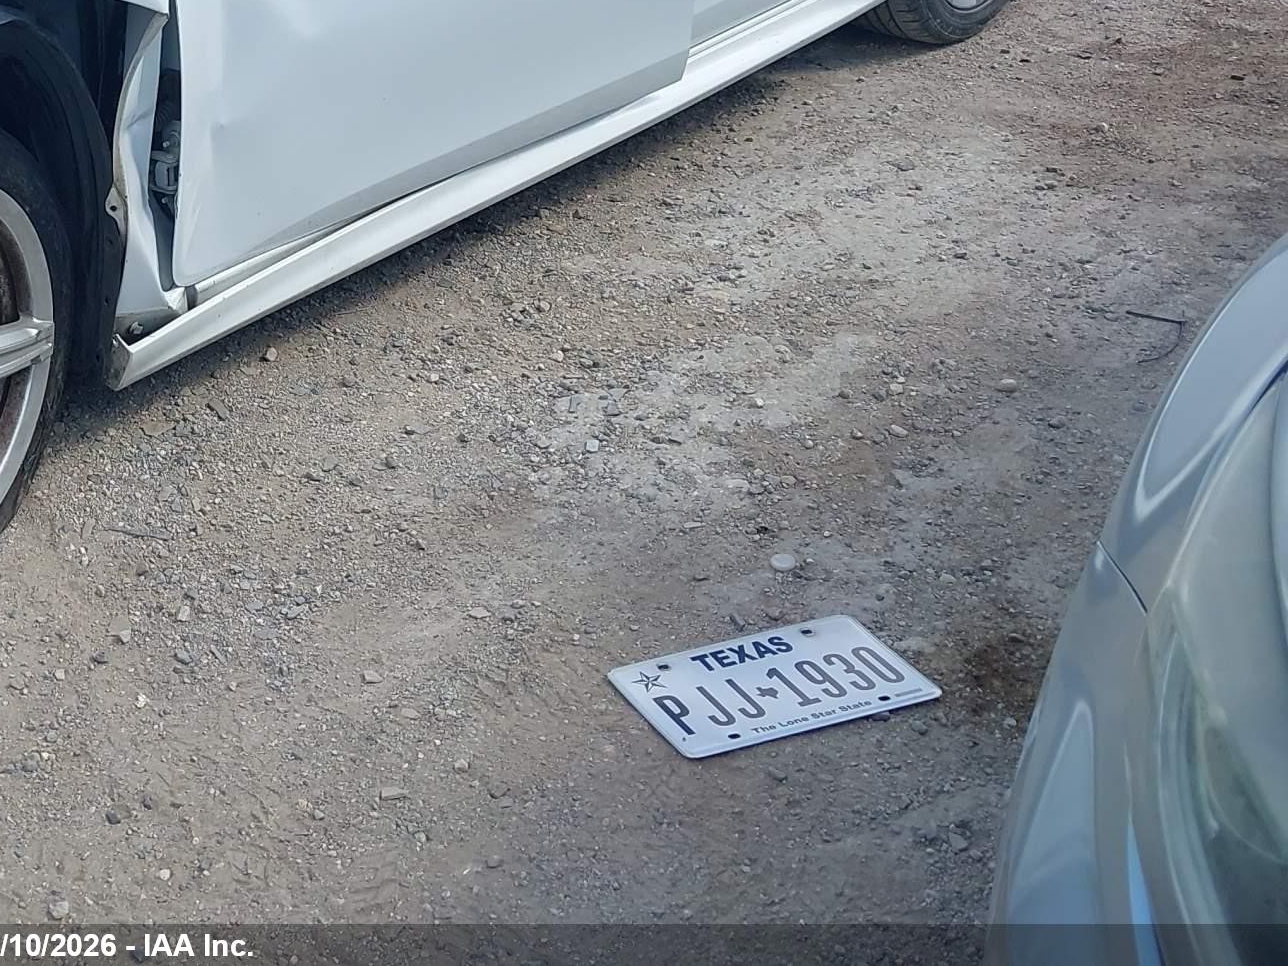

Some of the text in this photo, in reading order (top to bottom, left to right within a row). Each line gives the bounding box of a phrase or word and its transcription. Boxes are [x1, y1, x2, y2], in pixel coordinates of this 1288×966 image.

[690, 636, 794, 672] TEXAS
[751, 700, 872, 734] The Lone Star State
